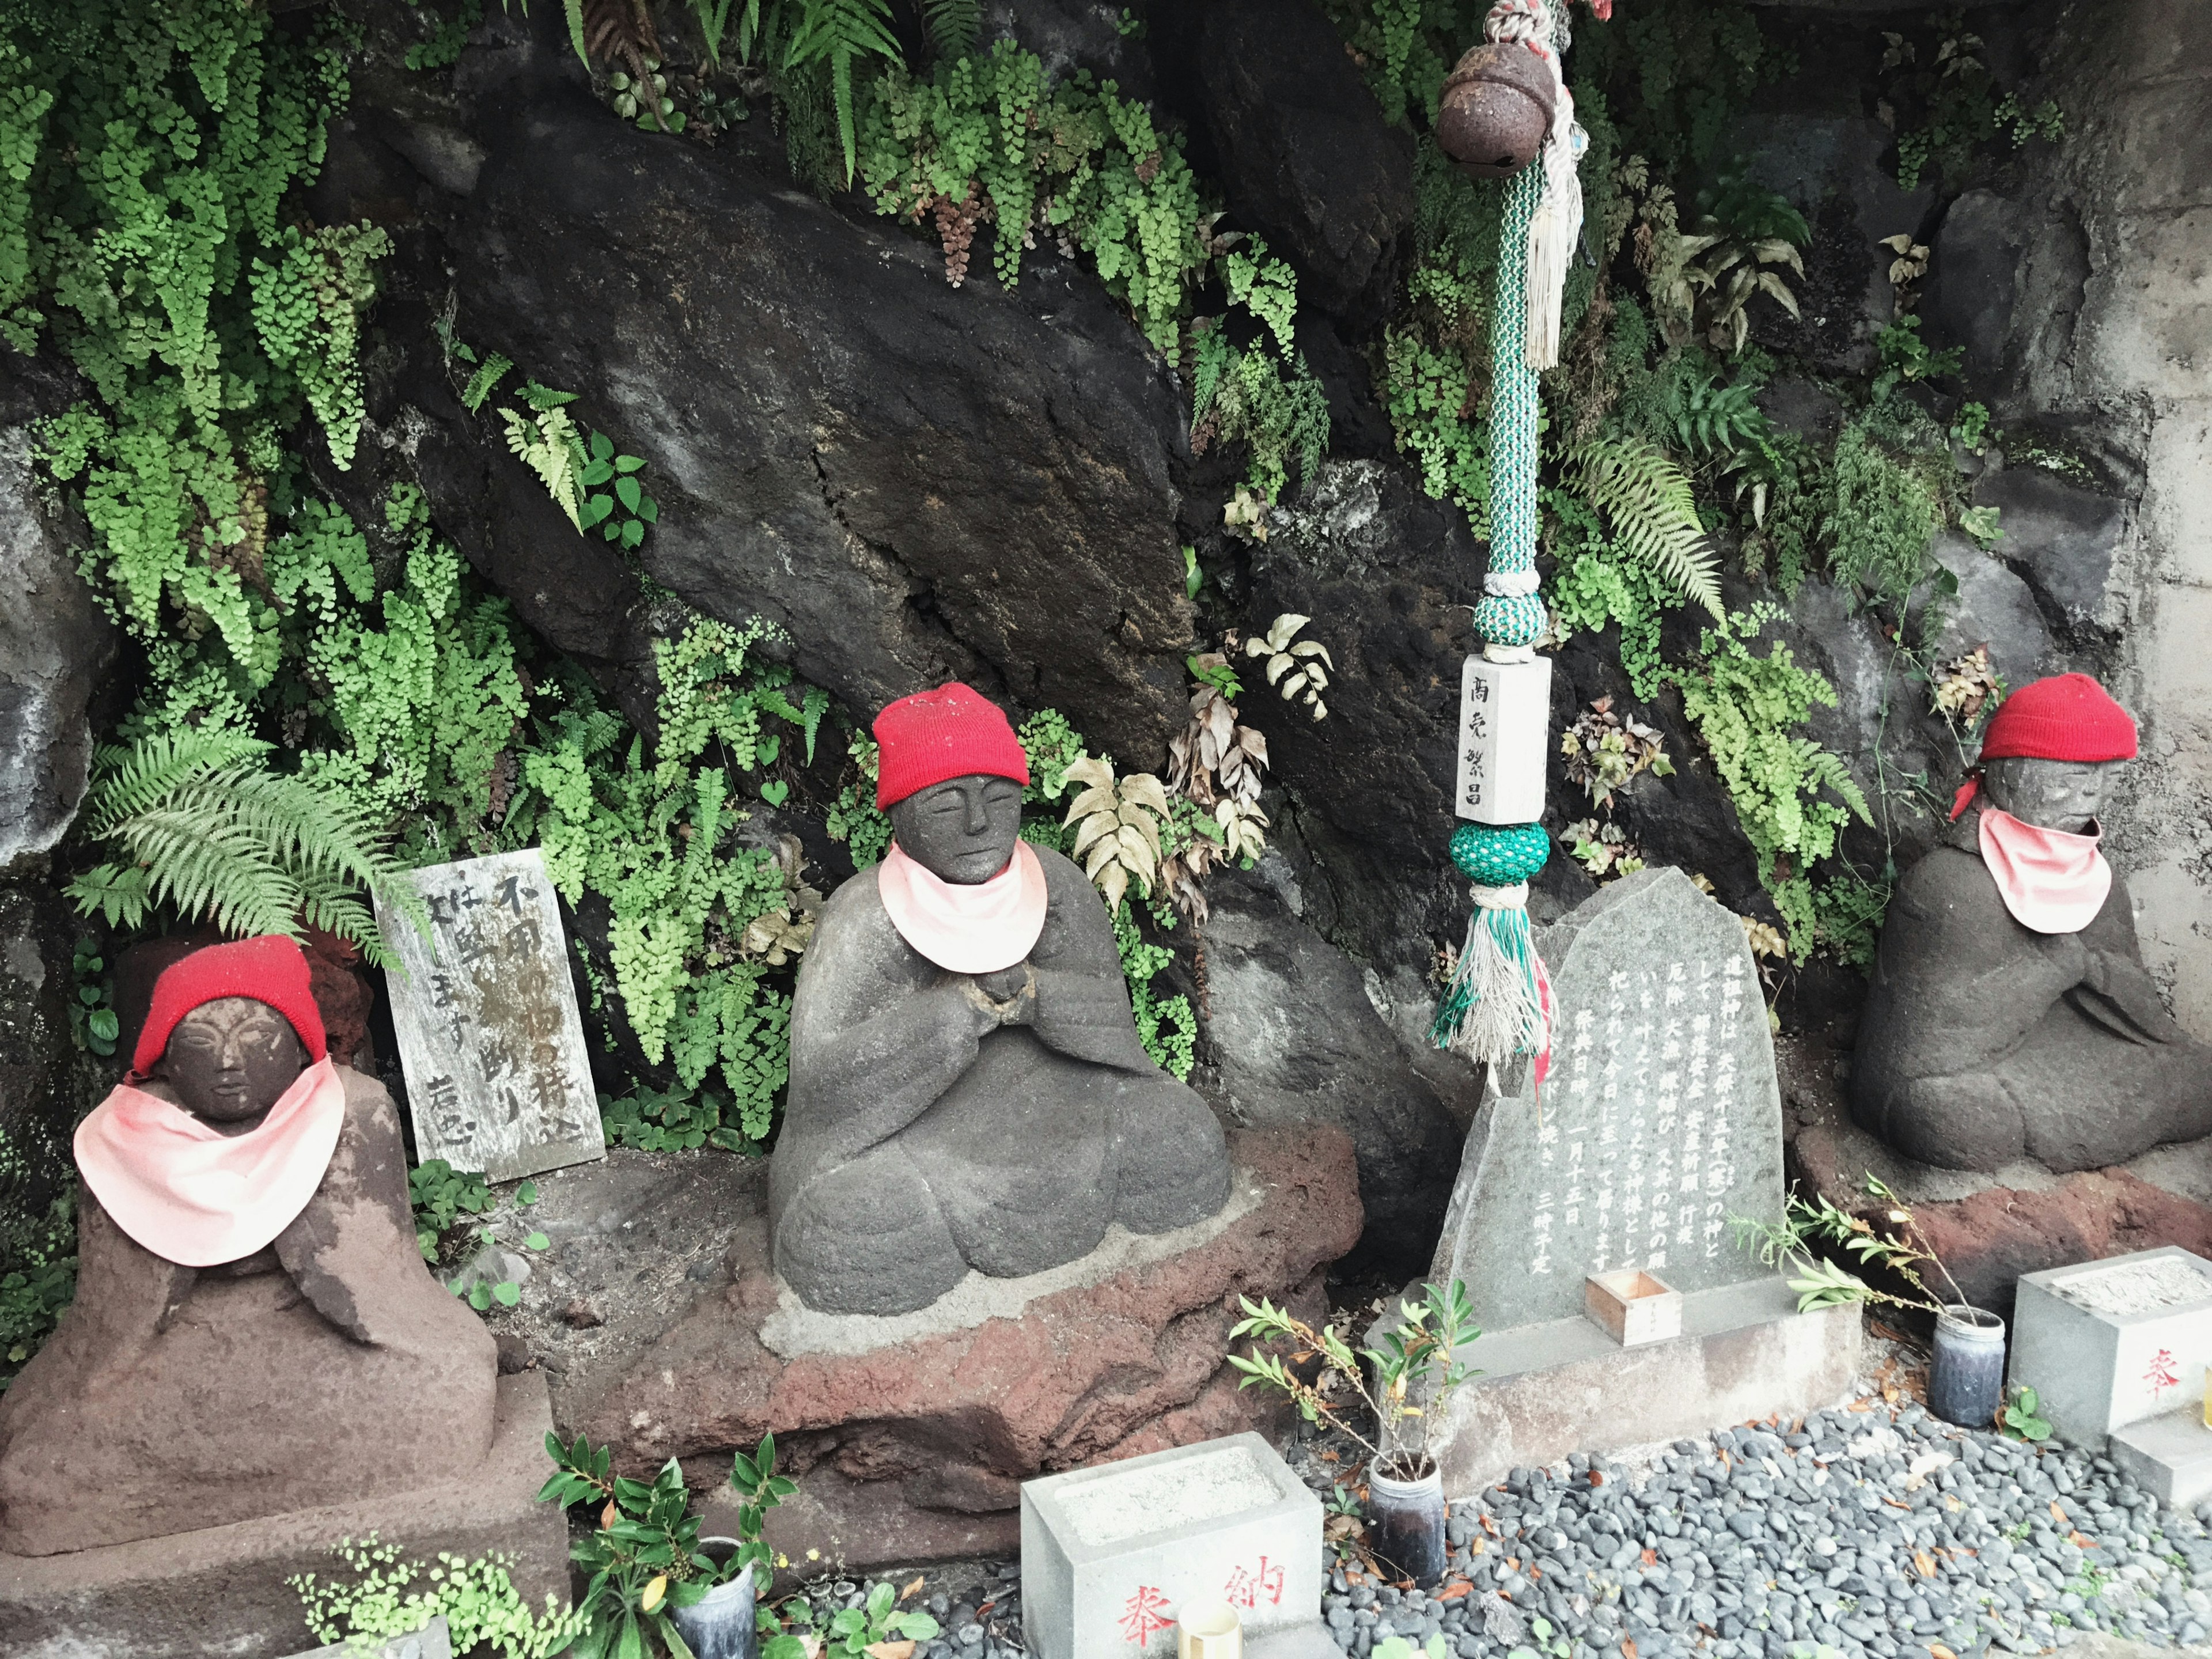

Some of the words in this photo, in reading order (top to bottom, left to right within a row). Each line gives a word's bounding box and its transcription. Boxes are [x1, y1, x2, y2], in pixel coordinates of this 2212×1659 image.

[1563, 1126, 1588, 1225] 一月十五日
[1532, 1192, 1555, 1275] 三時予定
[2142, 1349, 2181, 1402] 奉
